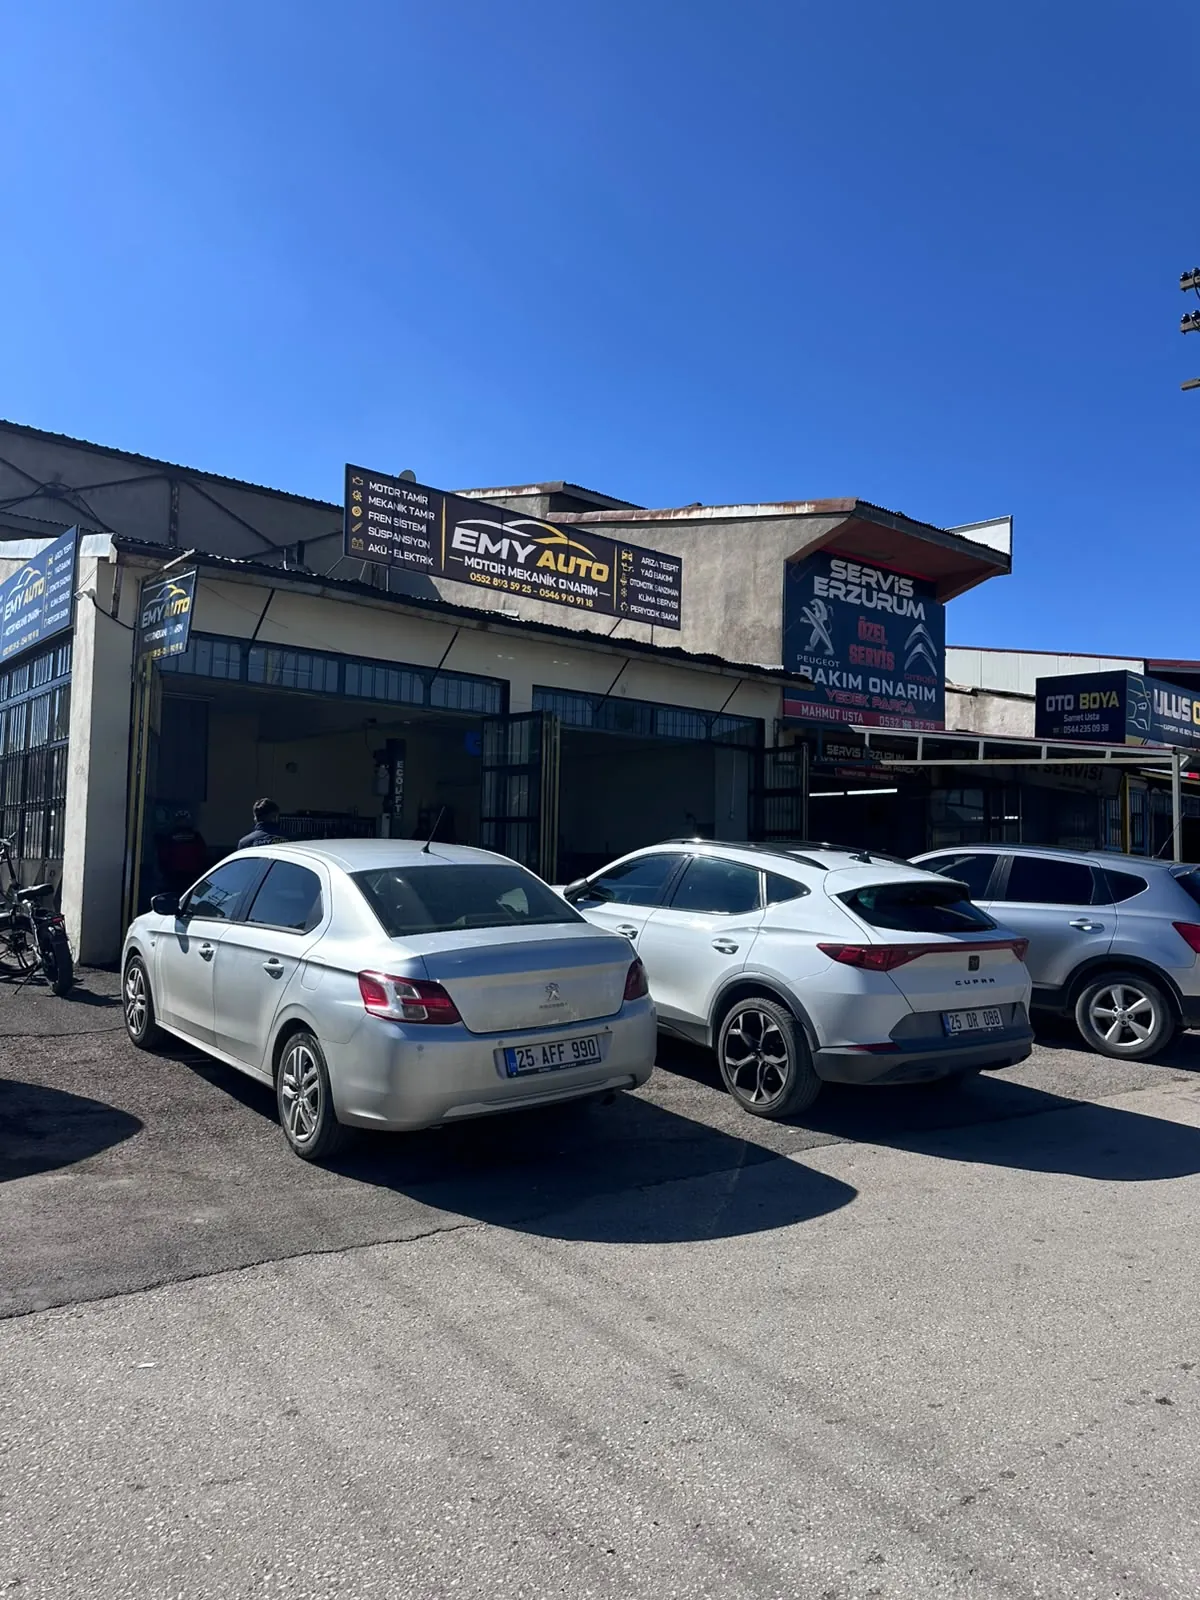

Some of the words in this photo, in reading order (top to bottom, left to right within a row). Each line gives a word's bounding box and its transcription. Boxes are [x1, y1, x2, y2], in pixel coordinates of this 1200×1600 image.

[368, 496, 408, 514] MEKANİK
[369, 481, 400, 498] MOTOR
[402, 490, 428, 505] TAMİR
[368, 511, 392, 524] FREN
[393, 517, 426, 534] SİSTEMİ
[368, 526, 430, 550] SÜSPANSİYON
[368, 543, 388, 554] AKÜ
[394, 548, 434, 566] ELEKTRİK
[451, 526, 538, 564] EMY
[536, 550, 610, 583] AUTO
[641, 556, 659, 568] ARIZA
[464, 556, 505, 576] MOTOR
[508, 566, 557, 588] MEKANİK
[558, 579, 598, 598] ONARIM
[470, 572, 491, 585] 0552
[492, 578, 508, 588] 893
[510, 581, 520, 591] 59
[522, 583, 532, 594] 25
[539, 588, 560, 601] 0546
[4, 592, 24, 622] EMY
[22, 576, 46, 606] AUTO
[638, 593, 656, 604] KLİMA
[814, 576, 926, 620] ERZURUM
[141, 603, 165, 629] EMY
[163, 596, 191, 619] AUTO
[858, 616, 888, 645] ÖZEL
[797, 654, 840, 668] PEUGEOT
[849, 644, 895, 672] SERVİS
[800, 665, 862, 691] BAKIM
[869, 676, 936, 702] ONARIM
[824, 688, 870, 708] YEDEK
[872, 697, 916, 716] PARÇA
[1046, 694, 1074, 712] OTO
[1079, 690, 1120, 710] BOYA
[1154, 688, 1192, 722] ULUS
[801, 704, 840, 721] MAHMUT
[842, 710, 864, 724] USTA
[880, 715, 900, 728] 0532
[1064, 713, 1084, 723] Samet
[1085, 712, 1100, 722] Usta
[950, 1014, 962, 1030] 25
[966, 1012, 980, 1028] DR
[516, 1048, 535, 1068] 25
[542, 1044, 564, 1064] AFF
[572, 1038, 596, 1059] 990
